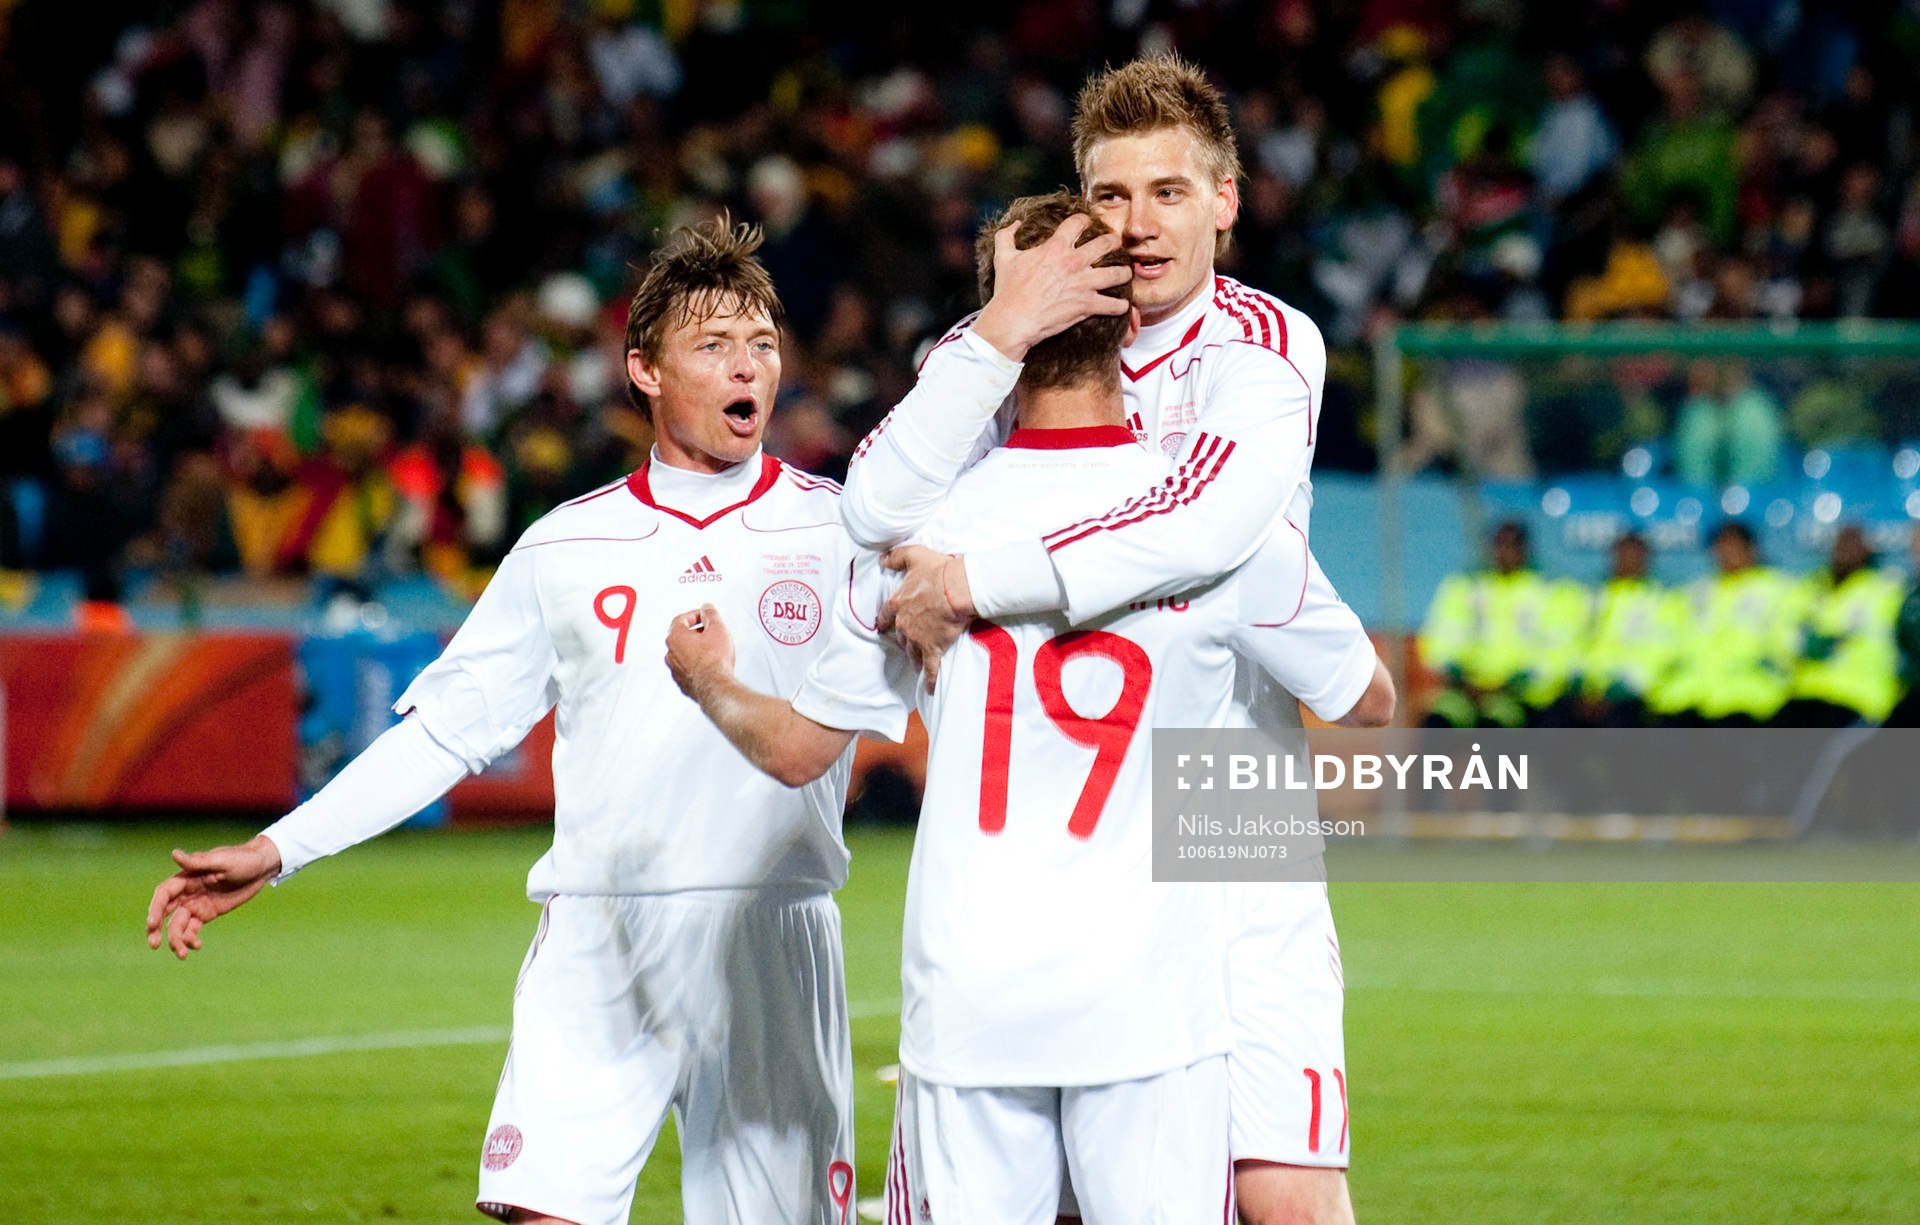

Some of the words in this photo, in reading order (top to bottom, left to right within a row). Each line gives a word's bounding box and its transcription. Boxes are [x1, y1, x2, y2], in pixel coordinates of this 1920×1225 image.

[678, 573, 722, 584] adidas
[773, 601, 807, 621] DBU
[593, 585, 637, 664] 9
[969, 618, 1153, 842] 19
[1303, 1067, 1349, 1154] 11
[827, 1160, 854, 1225] 9
